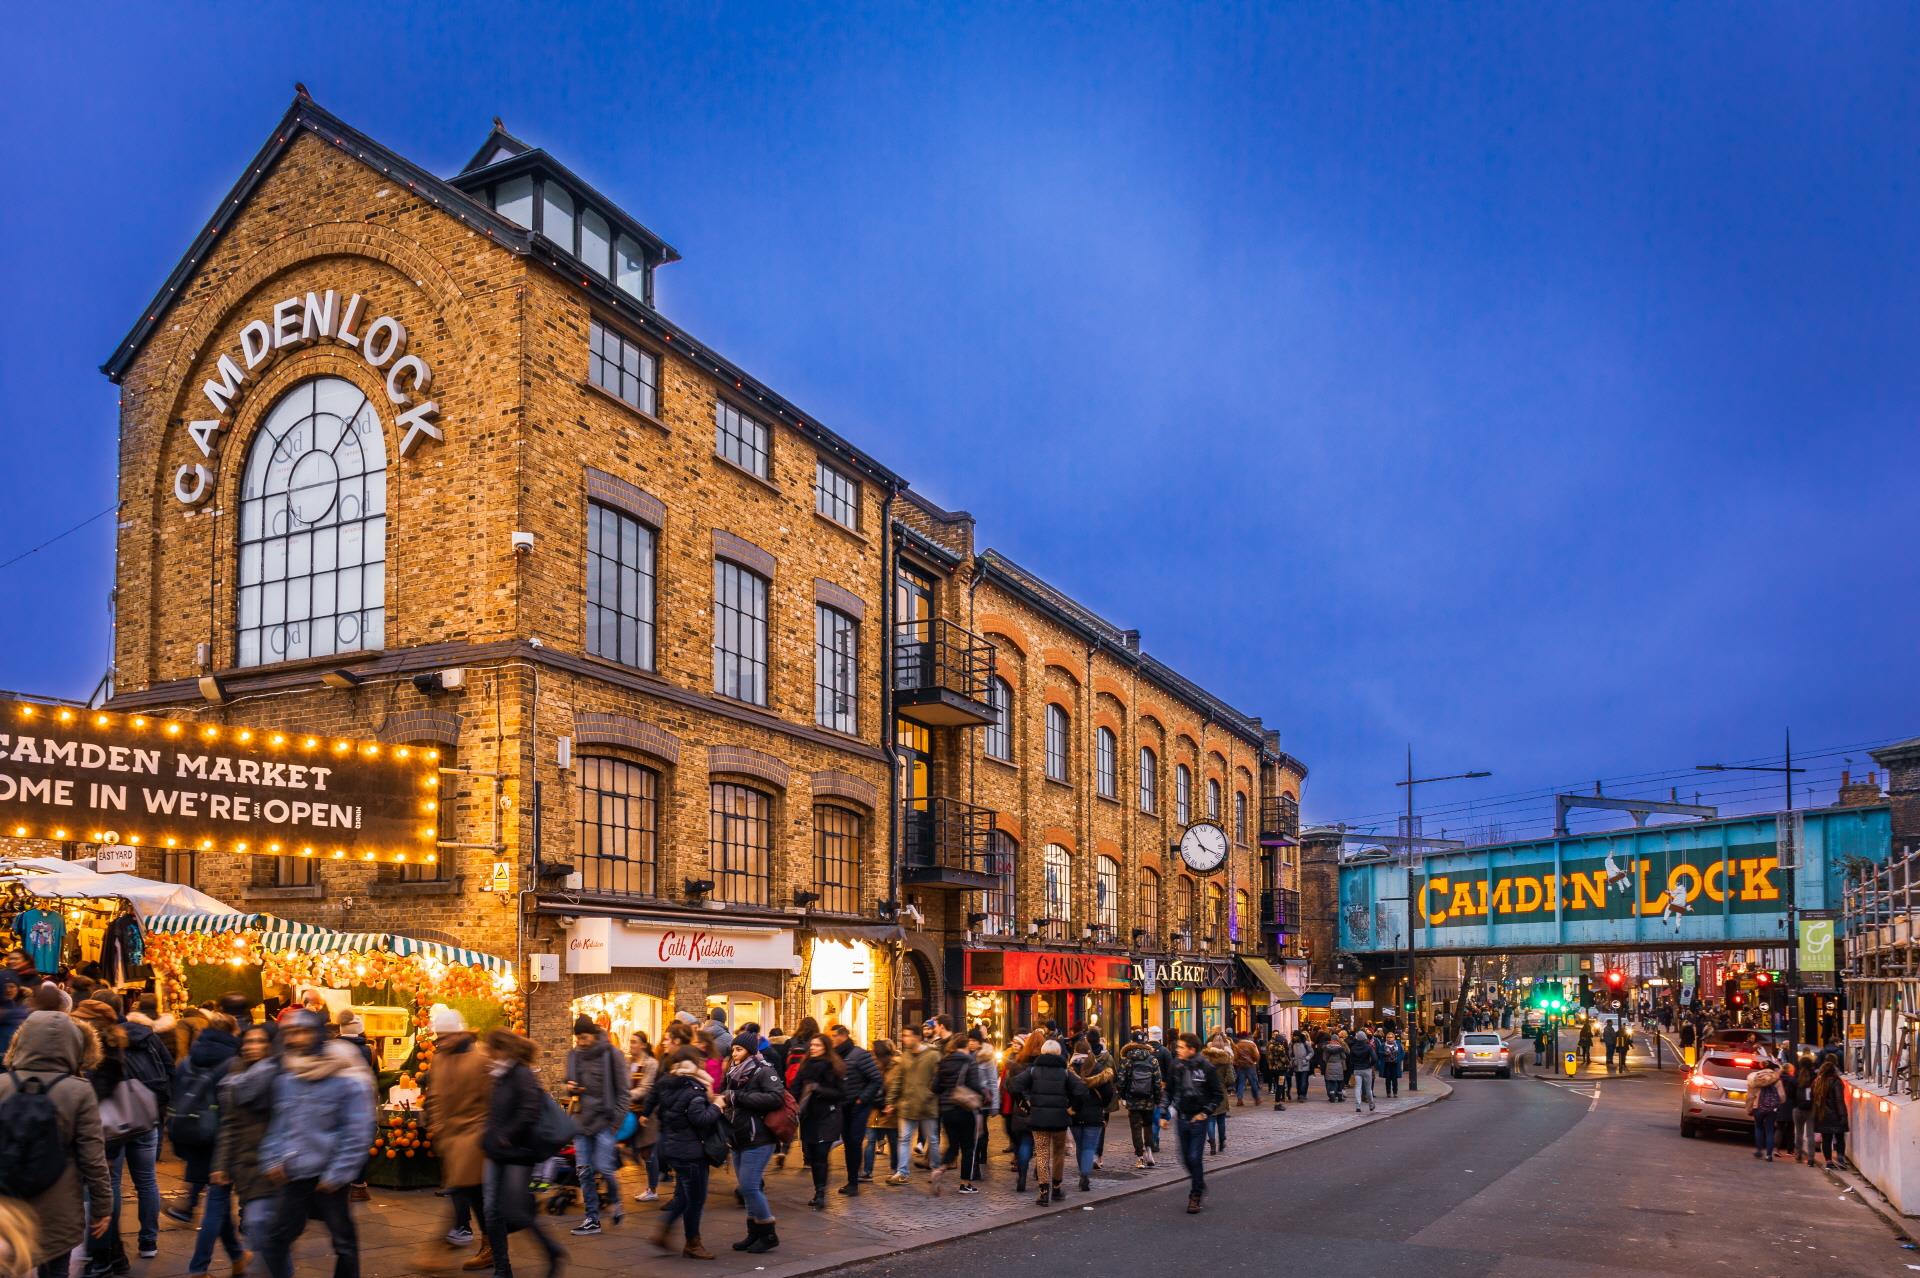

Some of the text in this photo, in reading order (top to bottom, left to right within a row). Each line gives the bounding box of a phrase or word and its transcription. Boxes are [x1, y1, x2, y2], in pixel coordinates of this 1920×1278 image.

[176, 753, 332, 791] MARKET
[0, 773, 353, 829] OME IN WE'RE OPEN
[253, 802, 261, 820] VERY
[98, 850, 133, 861] EAST YARD
[1418, 857, 1779, 925] CAMDEN LOCK
[658, 930, 736, 962] Cath Kidston
